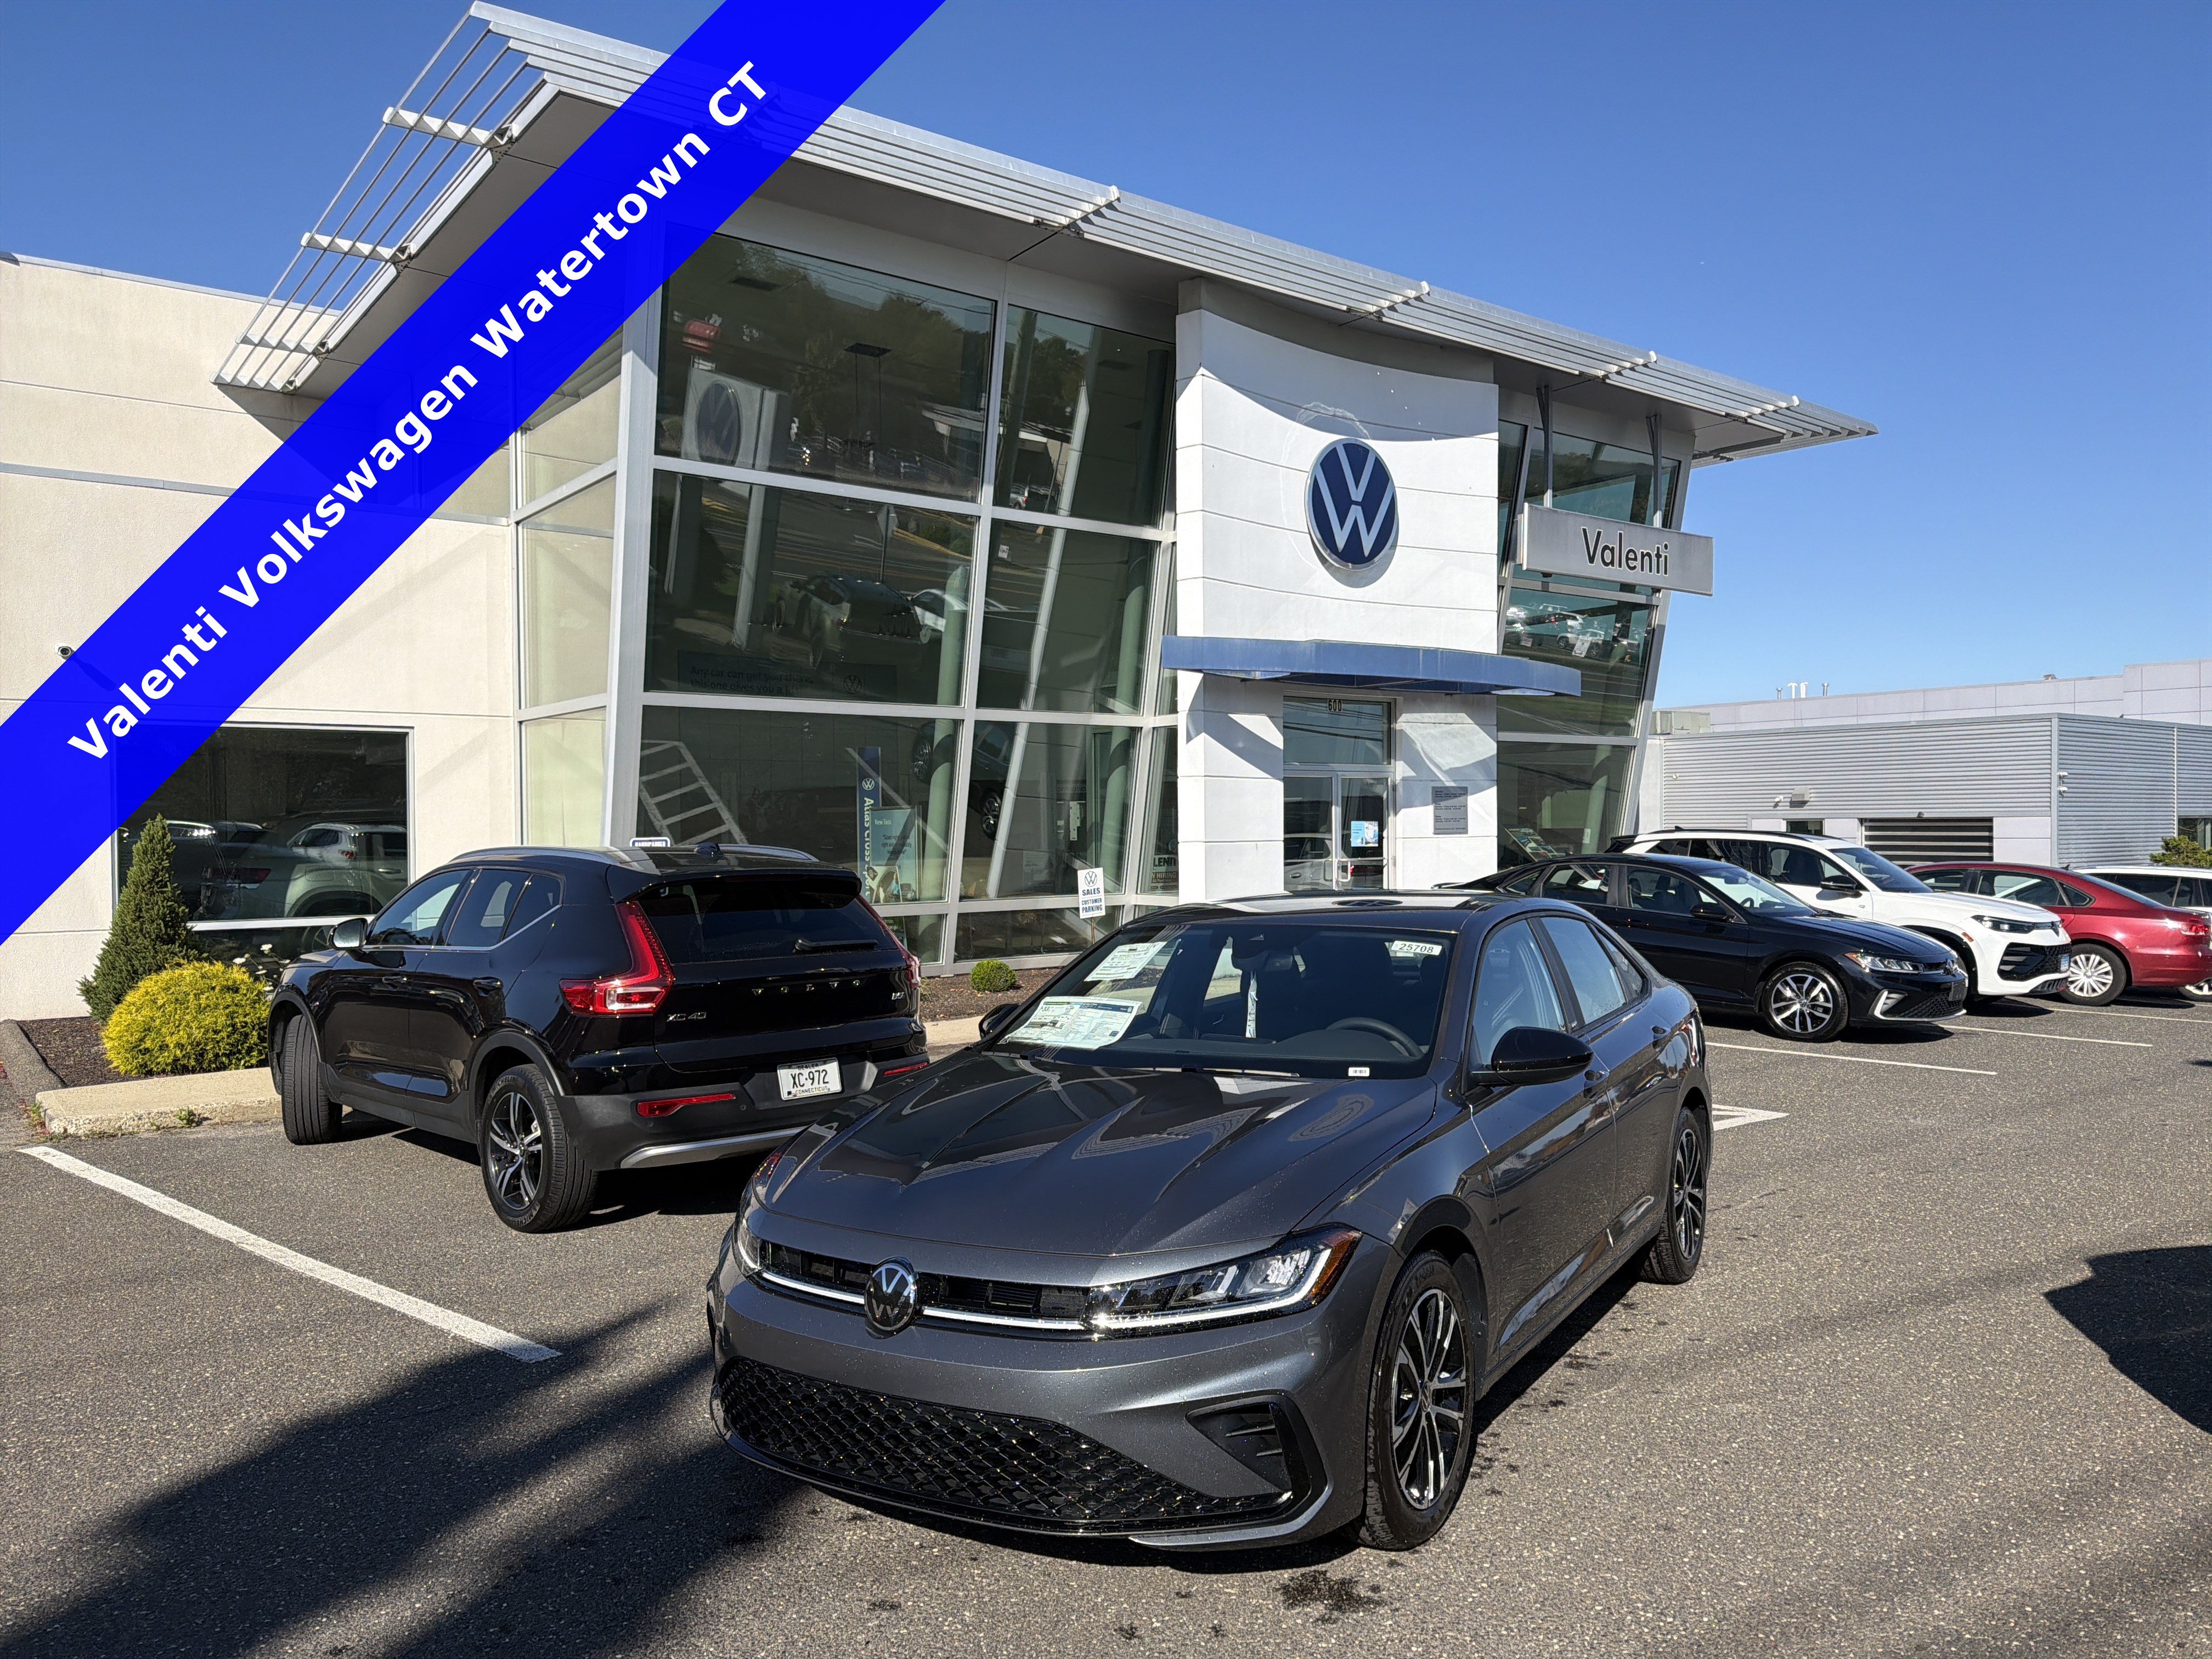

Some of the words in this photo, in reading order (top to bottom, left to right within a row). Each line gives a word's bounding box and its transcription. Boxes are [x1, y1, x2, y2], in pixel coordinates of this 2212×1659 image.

[1581, 526, 1669, 577] Valenti
[1327, 699, 1342, 712] 600
[1082, 887, 1101, 896] SALES
[1081, 898, 1102, 906] CUSTOMER
[1082, 904, 1103, 914] PARKING
[1398, 943, 1434, 953] 25708
[795, 1085, 827, 1096] CONNECTICUT
